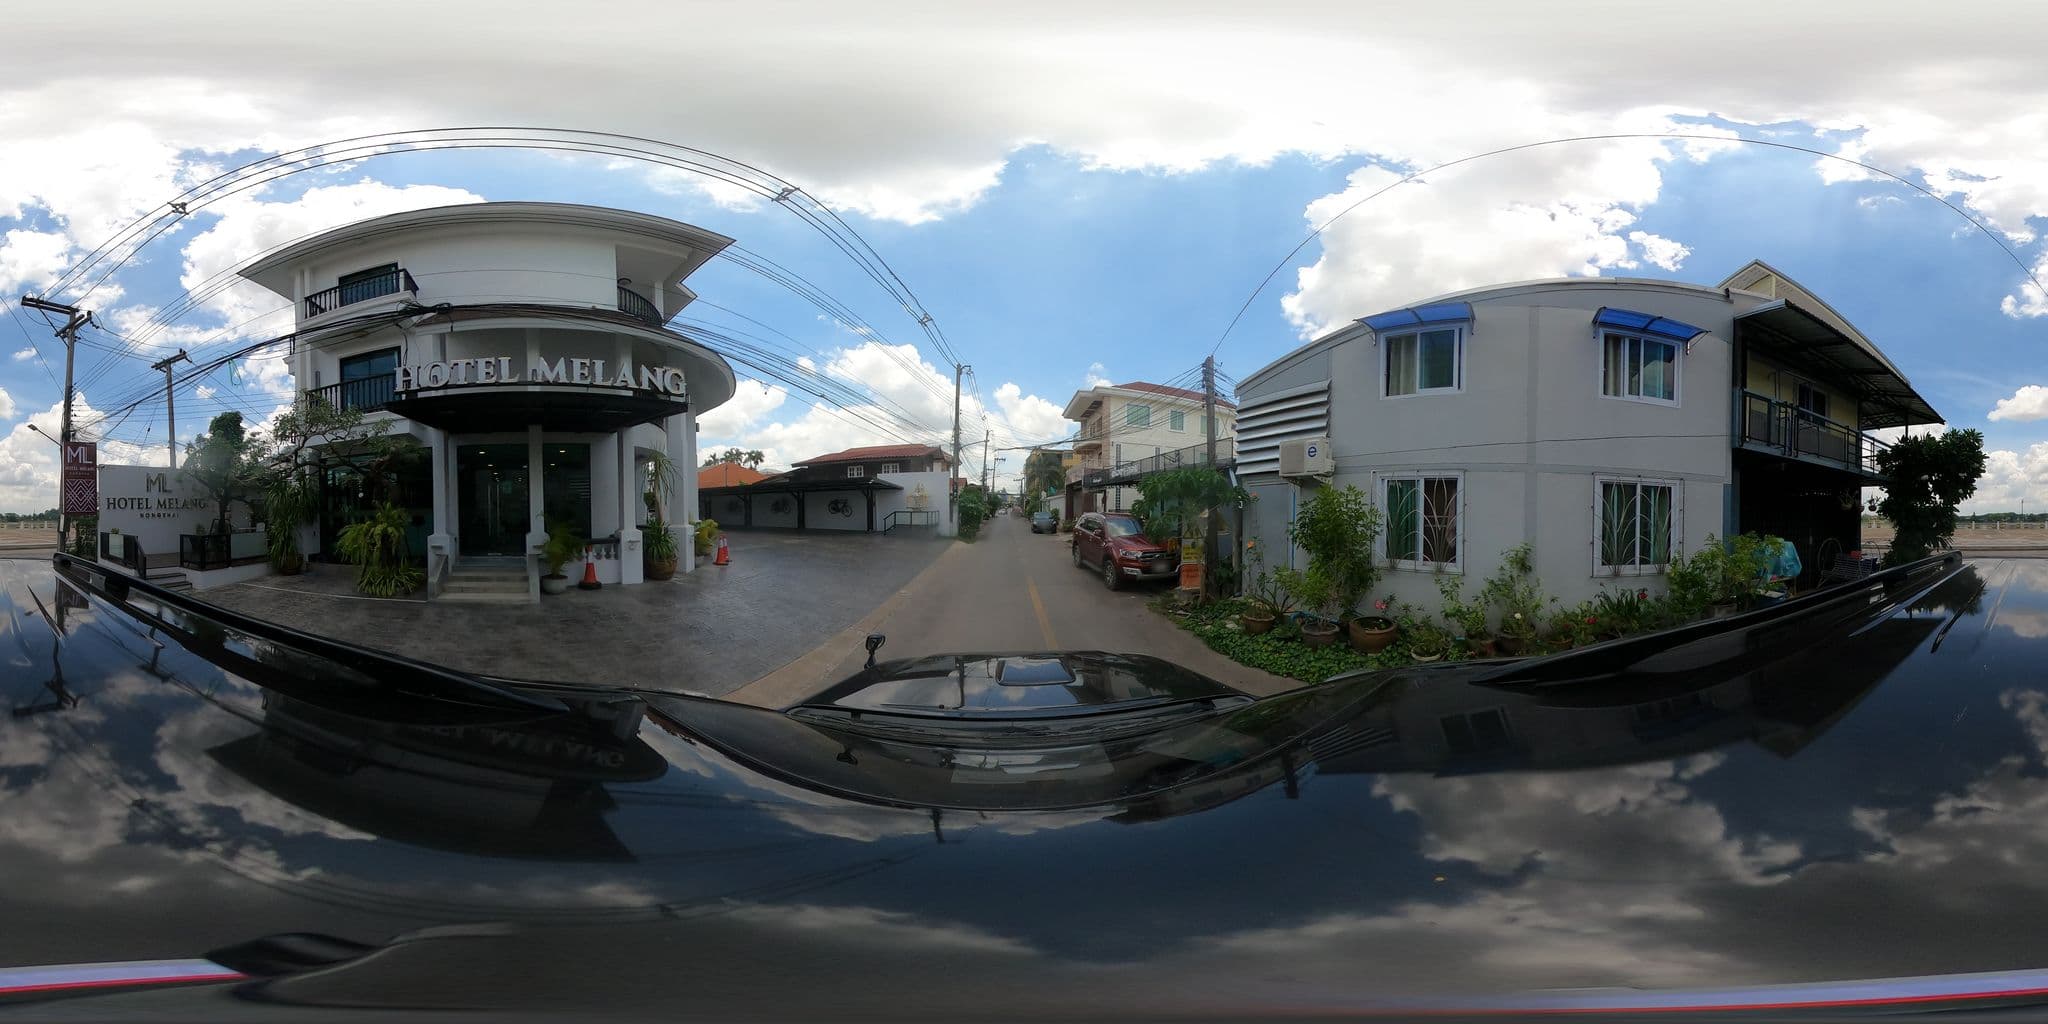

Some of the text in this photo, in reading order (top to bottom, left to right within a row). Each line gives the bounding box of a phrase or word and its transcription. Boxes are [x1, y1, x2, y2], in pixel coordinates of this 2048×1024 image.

[394, 356, 687, 395] HOTEL MELANG
[67, 445, 93, 464] ML
[146, 472, 173, 493] ML
[105, 497, 207, 510] HOTEL MELANG
